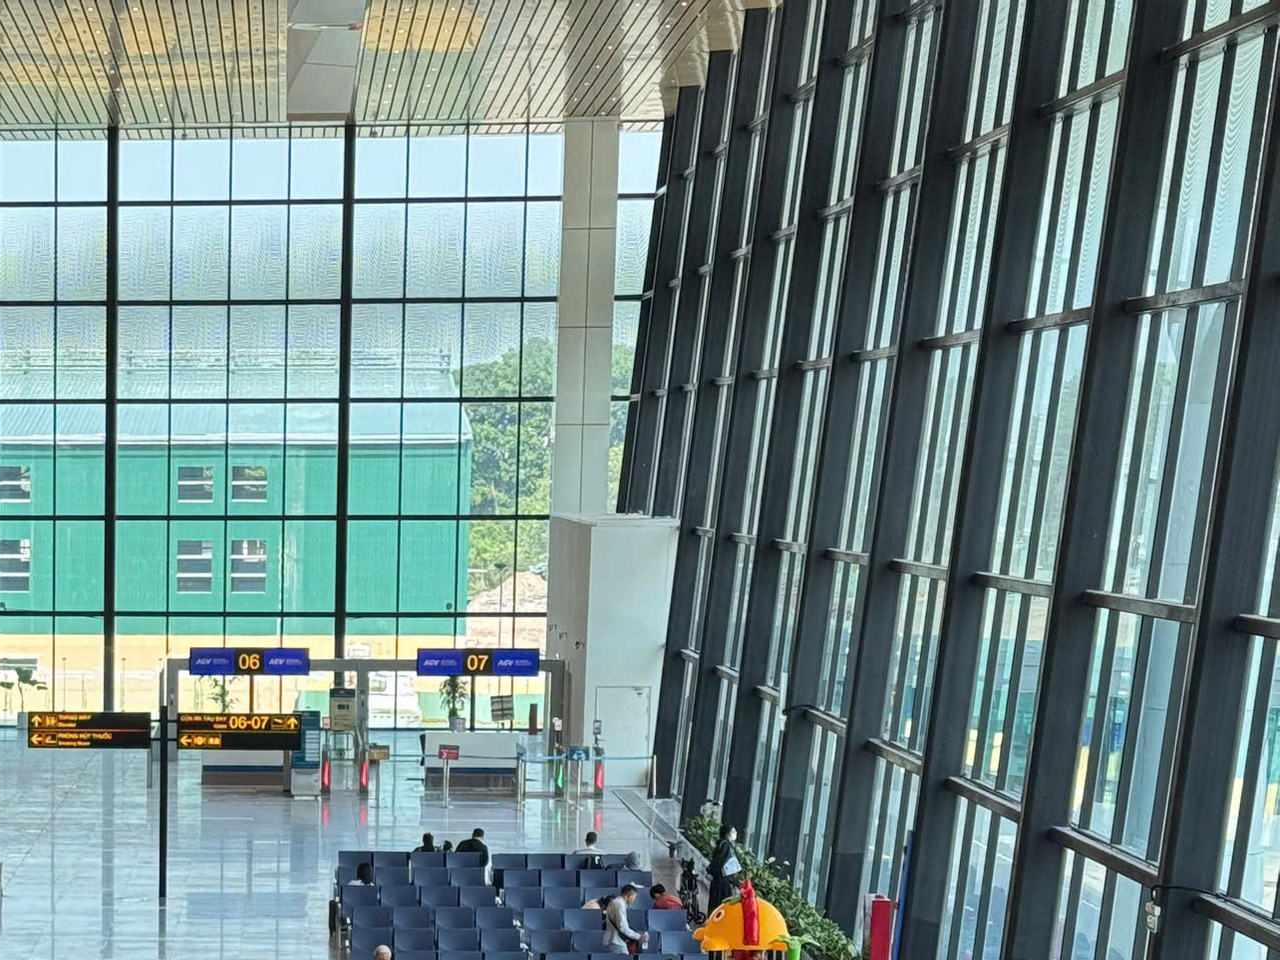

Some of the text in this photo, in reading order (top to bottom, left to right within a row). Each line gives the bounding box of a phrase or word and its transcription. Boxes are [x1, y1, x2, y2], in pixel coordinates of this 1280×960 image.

[238, 654, 260, 670] 06
[466, 655, 489, 670] 07
[229, 716, 269, 729] 06-07
